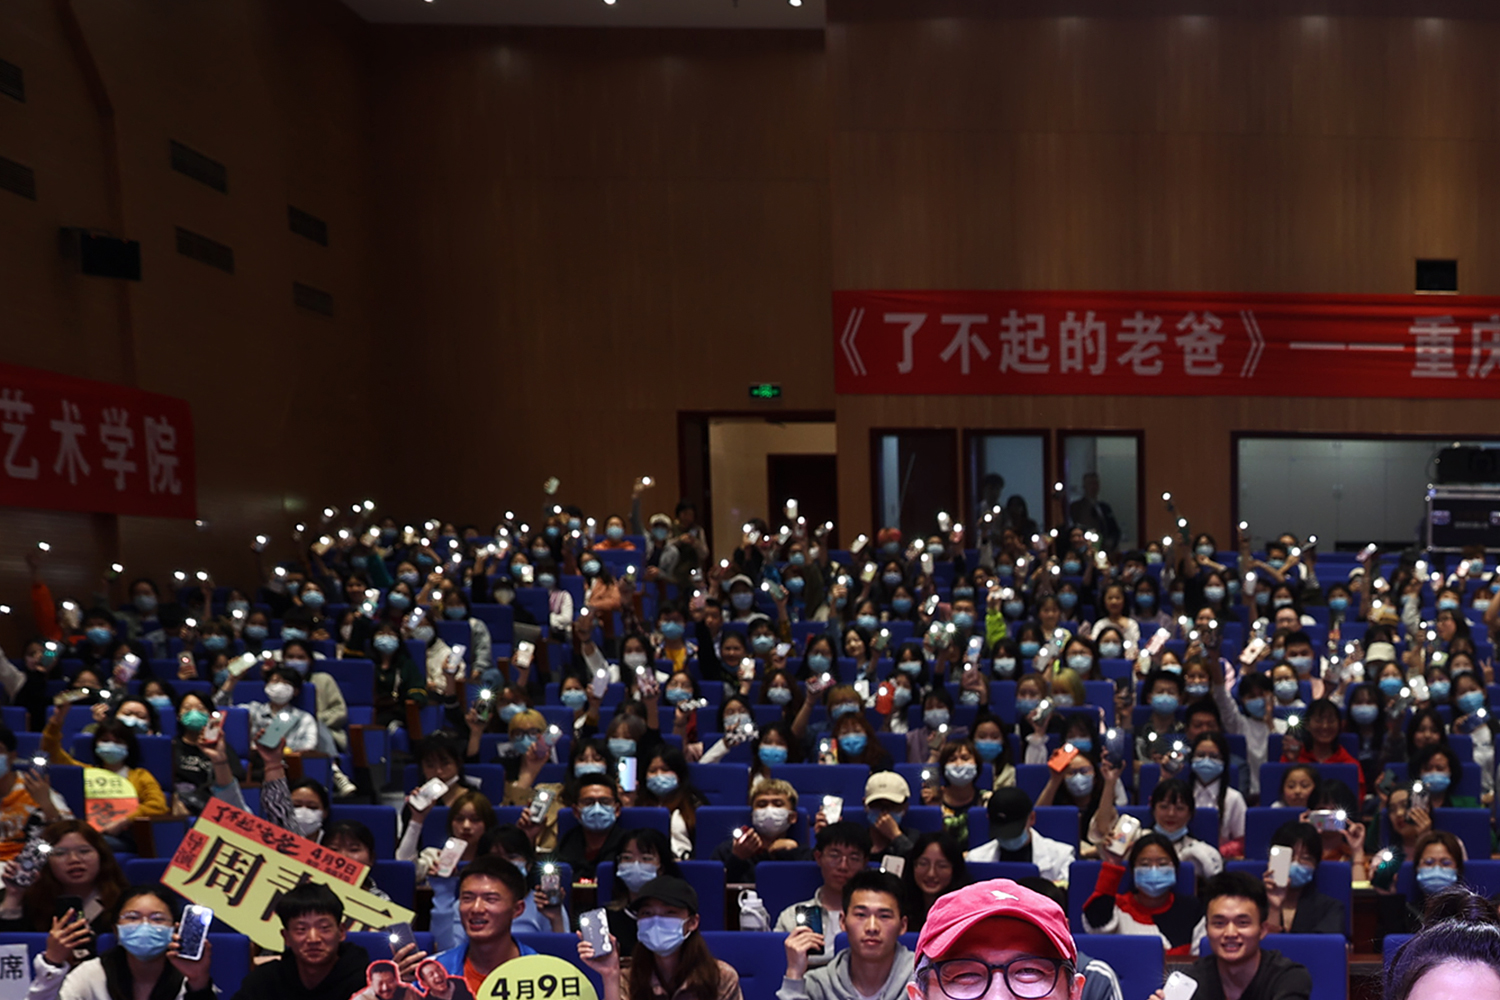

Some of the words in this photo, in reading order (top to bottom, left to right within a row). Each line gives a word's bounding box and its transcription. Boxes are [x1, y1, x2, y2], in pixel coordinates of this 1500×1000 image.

[0, 388, 182, 495] 艺术学院
[210, 804, 300, 856] 了不起的老爸
[310, 847, 357, 875] 4月9日
[0, 954, 24, 980] 席
[491, 974, 581, 1000] 4月9日
